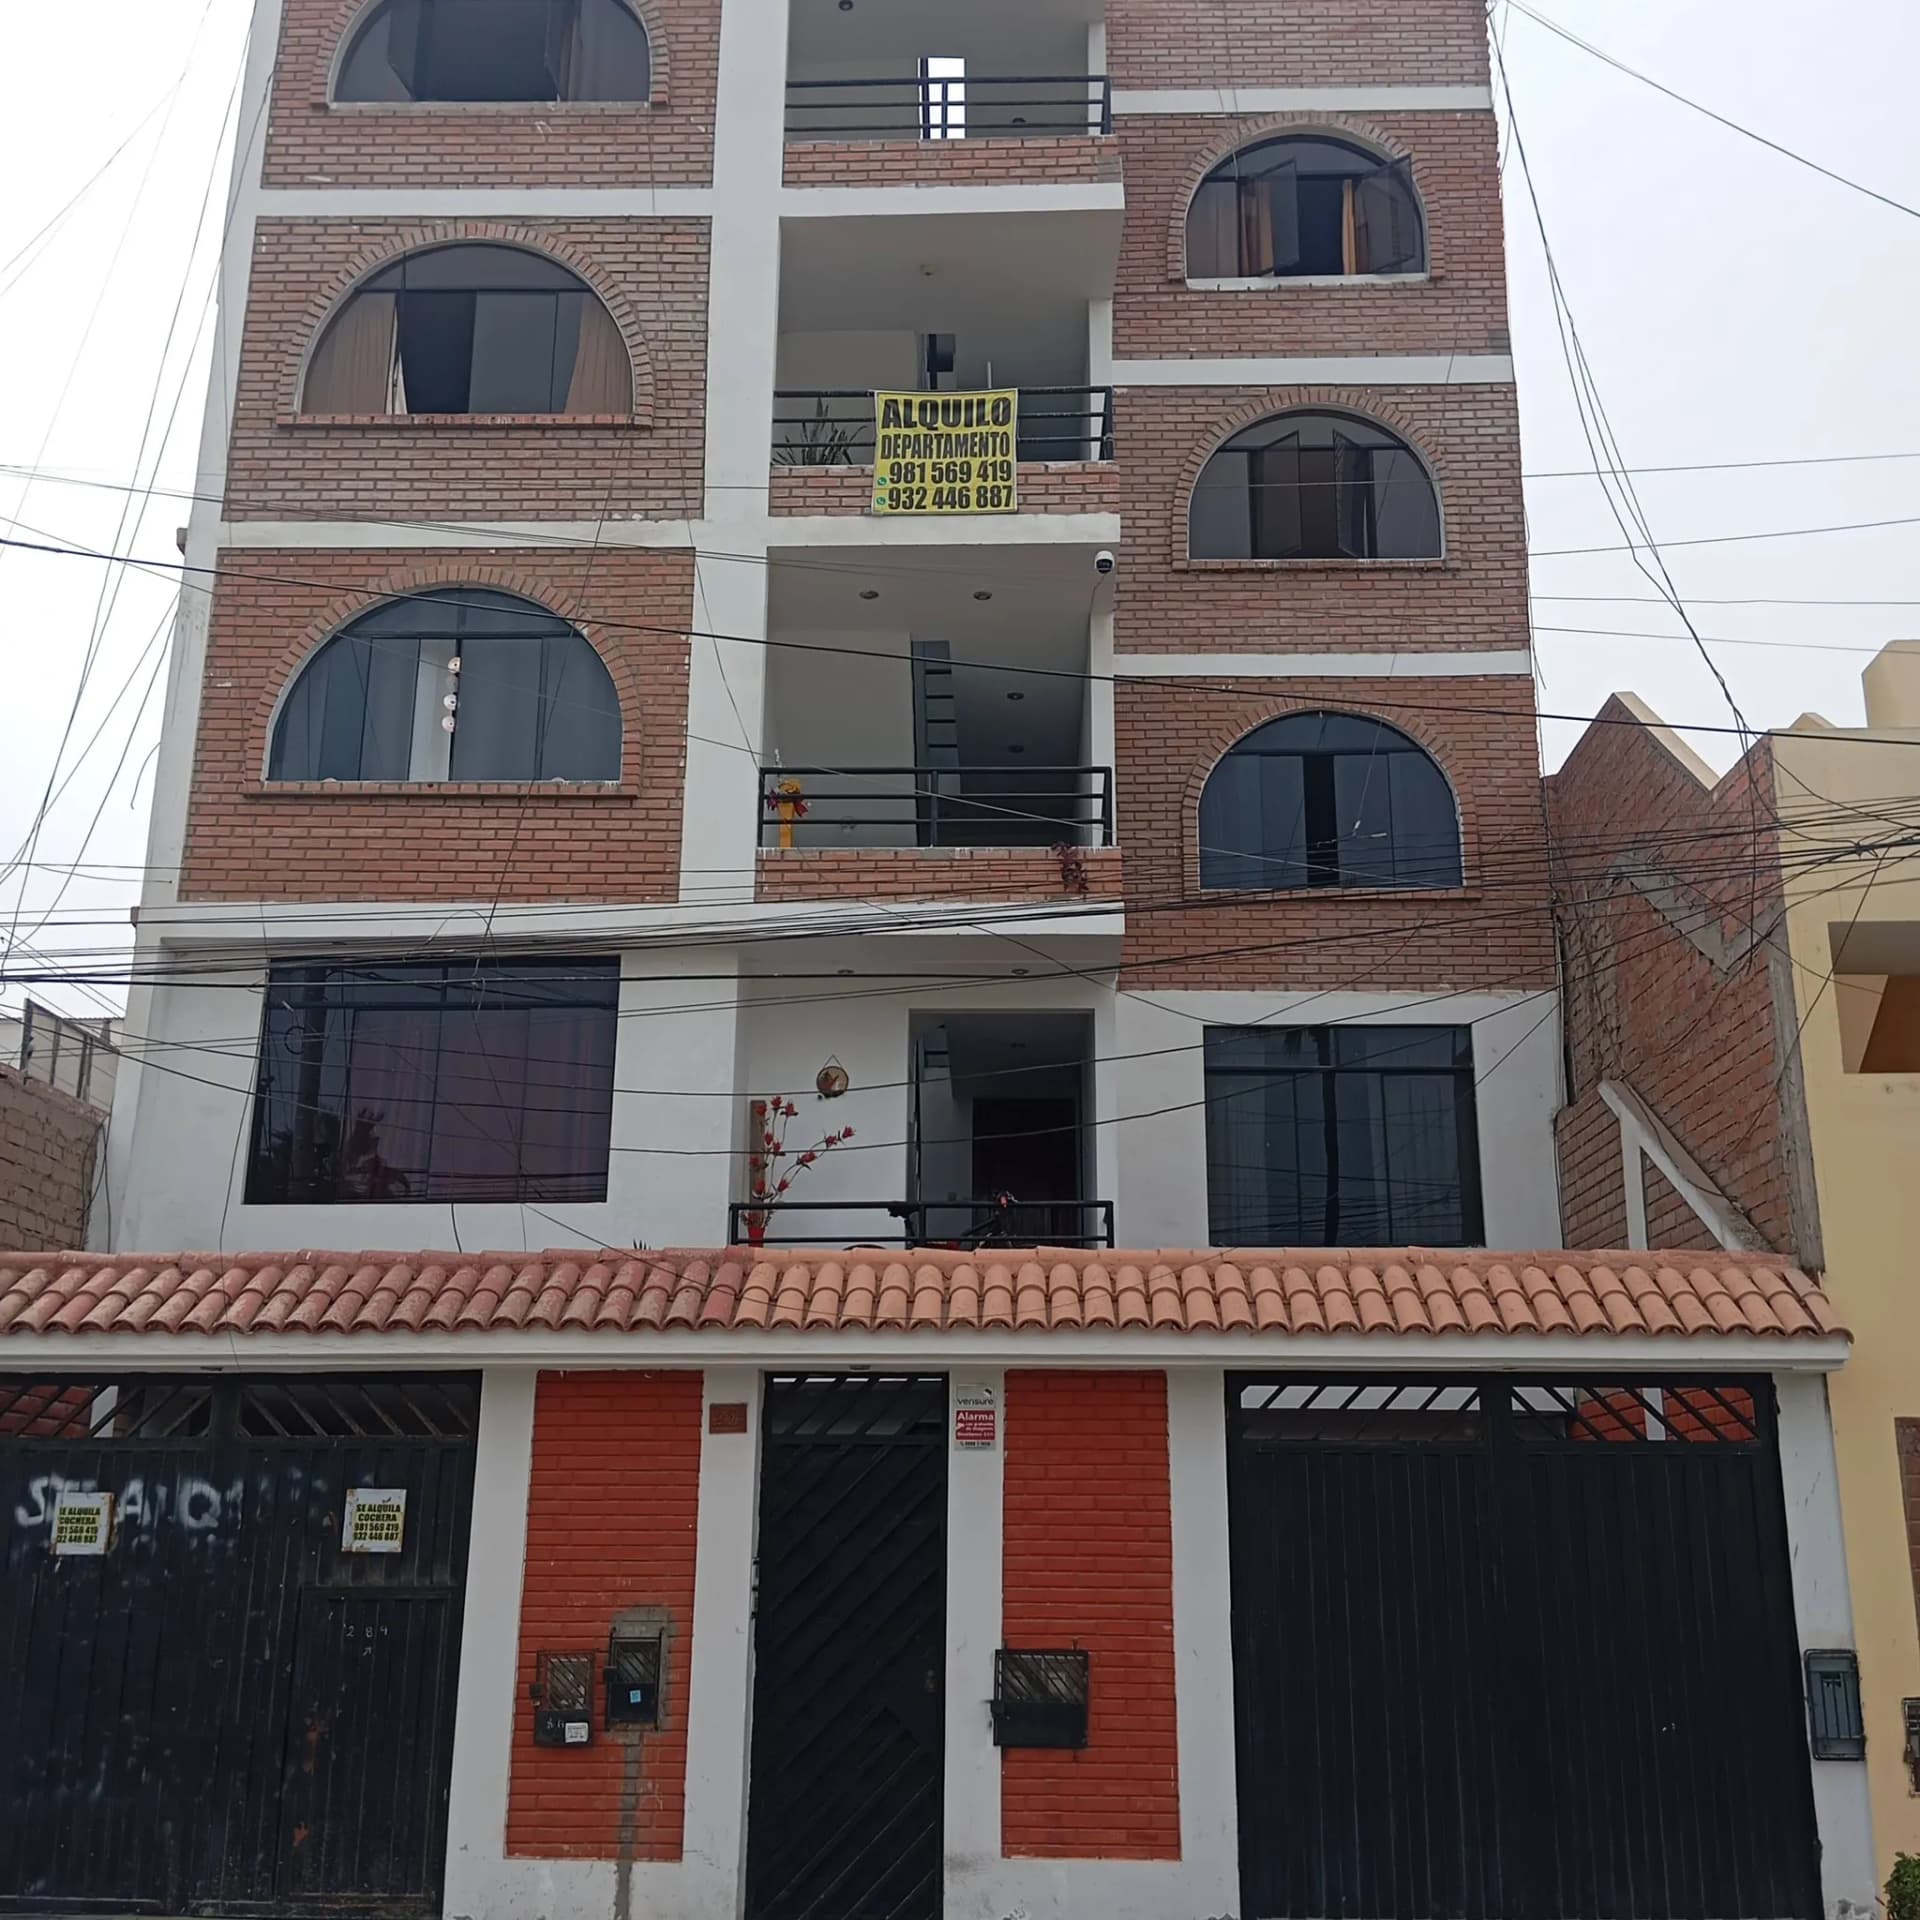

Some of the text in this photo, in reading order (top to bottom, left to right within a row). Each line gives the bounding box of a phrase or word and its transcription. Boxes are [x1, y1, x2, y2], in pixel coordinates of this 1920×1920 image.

[881, 397, 1011, 430] ALQUILO
[880, 431, 1010, 459] DEPARTAMENTO
[889, 459, 1012, 484] 981 569 419
[888, 484, 1013, 510] 932 446 887
[958, 1411, 994, 1421] Alarma
[68, 1507, 101, 1516] ALQUILA
[356, 1503, 401, 1513] SE ALQUILA
[59, 1516, 96, 1525] COCHERA
[358, 1513, 397, 1522] COCHERA
[354, 1522, 369, 1531] 981
[369, 1522, 385, 1531] 569
